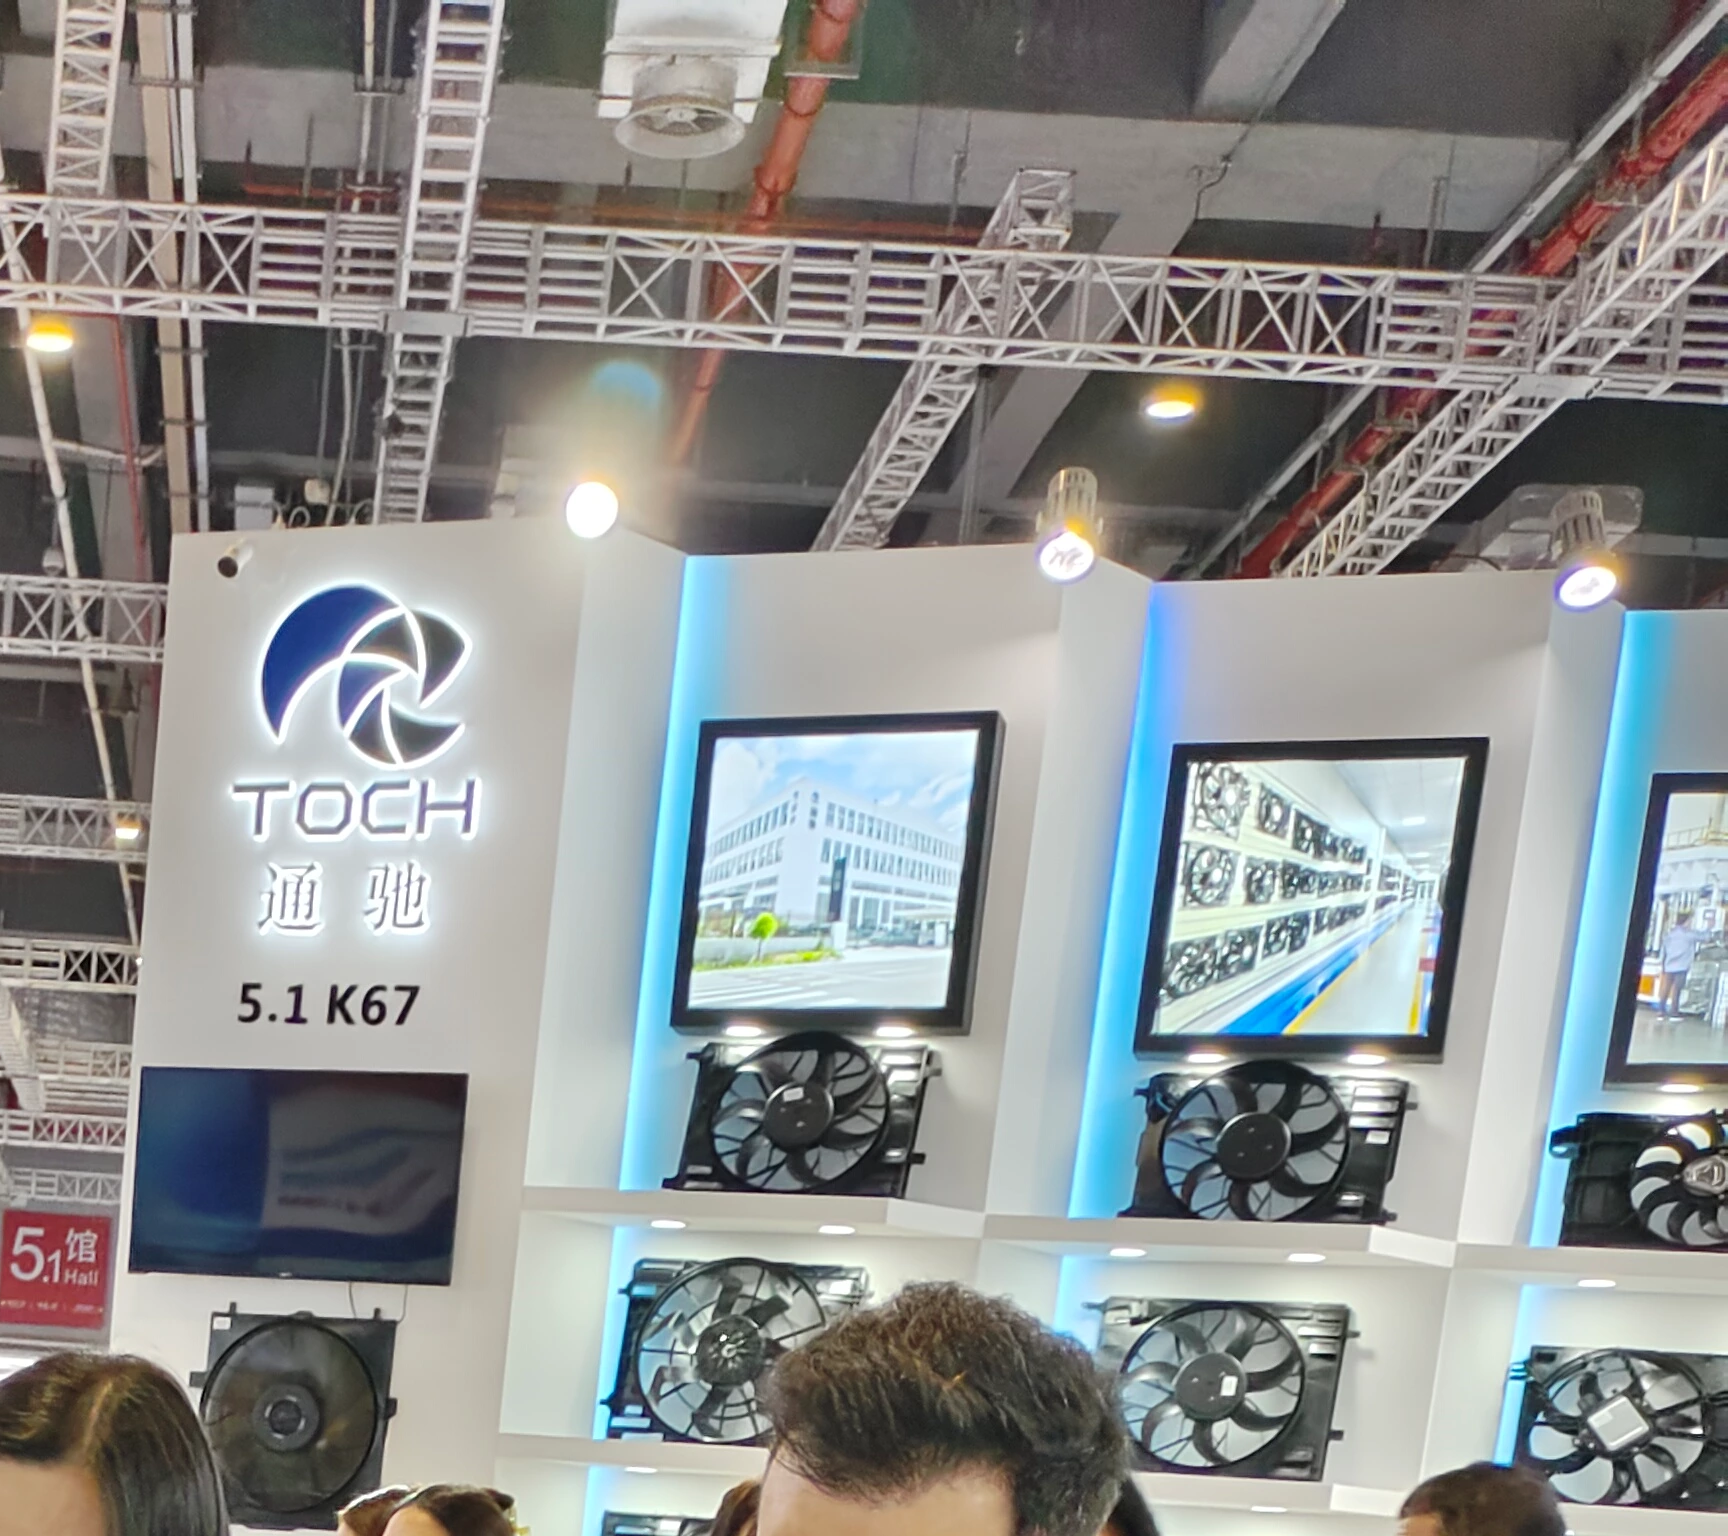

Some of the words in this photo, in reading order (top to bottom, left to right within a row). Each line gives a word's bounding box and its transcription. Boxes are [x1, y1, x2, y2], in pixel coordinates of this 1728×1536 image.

[231, 778, 478, 838] TOCH
[257, 860, 430, 933] 通驰
[237, 982, 309, 1025] 5.1
[326, 983, 421, 1026] K67
[9, 1226, 62, 1284] 5.1
[65, 1227, 99, 1264] 馆
[64, 1268, 99, 1287] Hall
